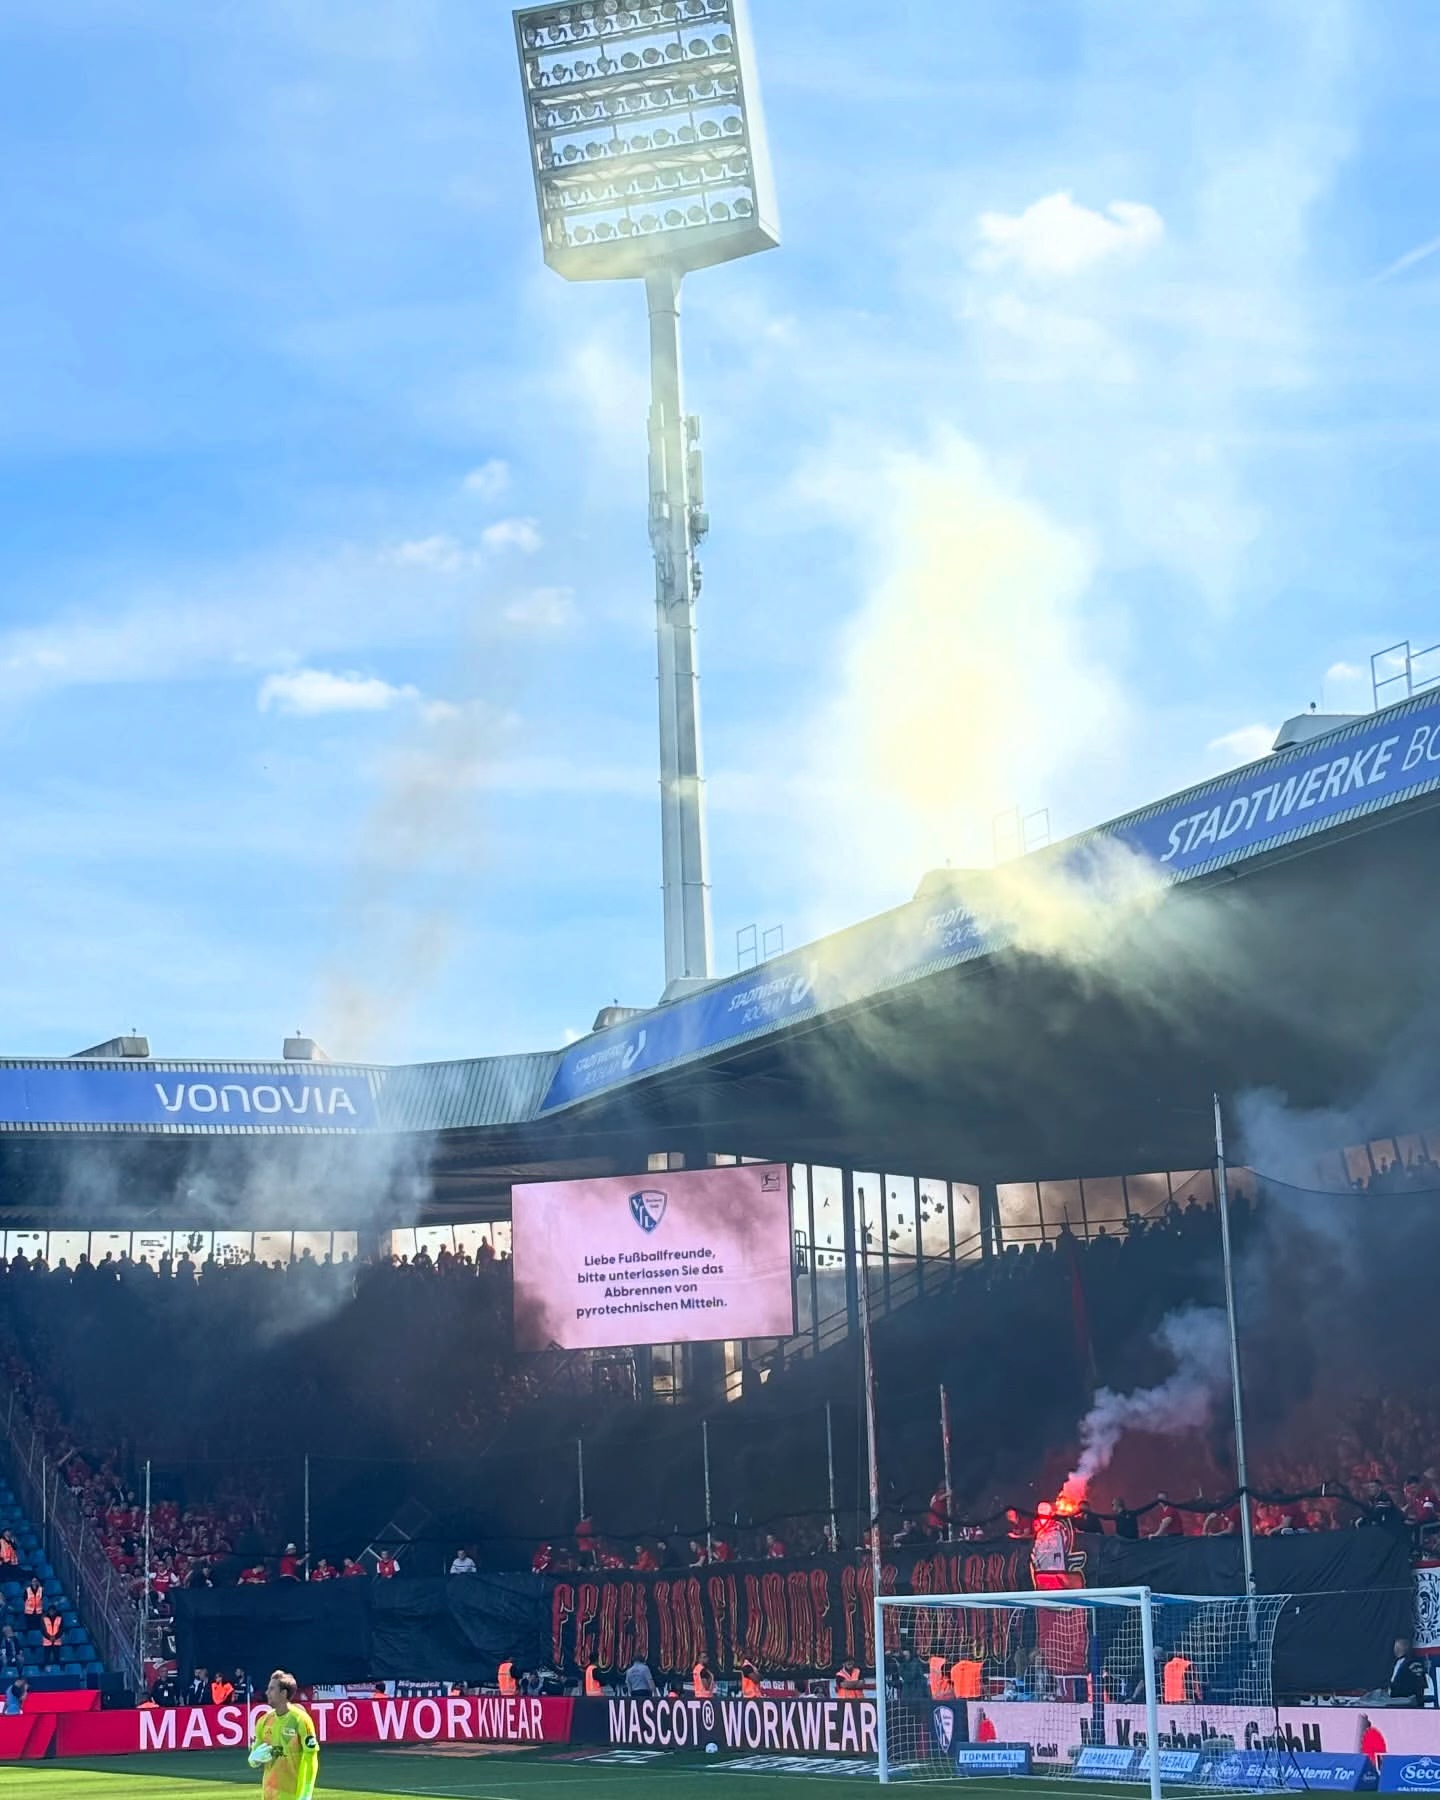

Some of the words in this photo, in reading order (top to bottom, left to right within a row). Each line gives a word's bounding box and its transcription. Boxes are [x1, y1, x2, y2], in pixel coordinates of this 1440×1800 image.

[1160, 735, 1400, 863] STADTWERKE
[584, 1254, 616, 1267] Liebe
[618, 1247, 716, 1264] Fußballfreunde,
[577, 1271, 606, 1284] bitte
[608, 1267, 680, 1282] unterlassen
[681, 1265, 699, 1277] Sie
[701, 1263, 724, 1275] das
[604, 1285, 672, 1298] Abbrennen
[674, 1283, 698, 1294] von
[576, 1300, 679, 1320] pyrotechnischen
[680, 1297, 728, 1311] Mitteln.
[373, 1697, 545, 1741] WORKWEAR
[721, 1700, 878, 1753] WORKWEAR
[1244, 1720, 1323, 1753] GmbH
[1036, 1742, 1059, 1757] GmbH
[1333, 1767, 1355, 1780] Tor
